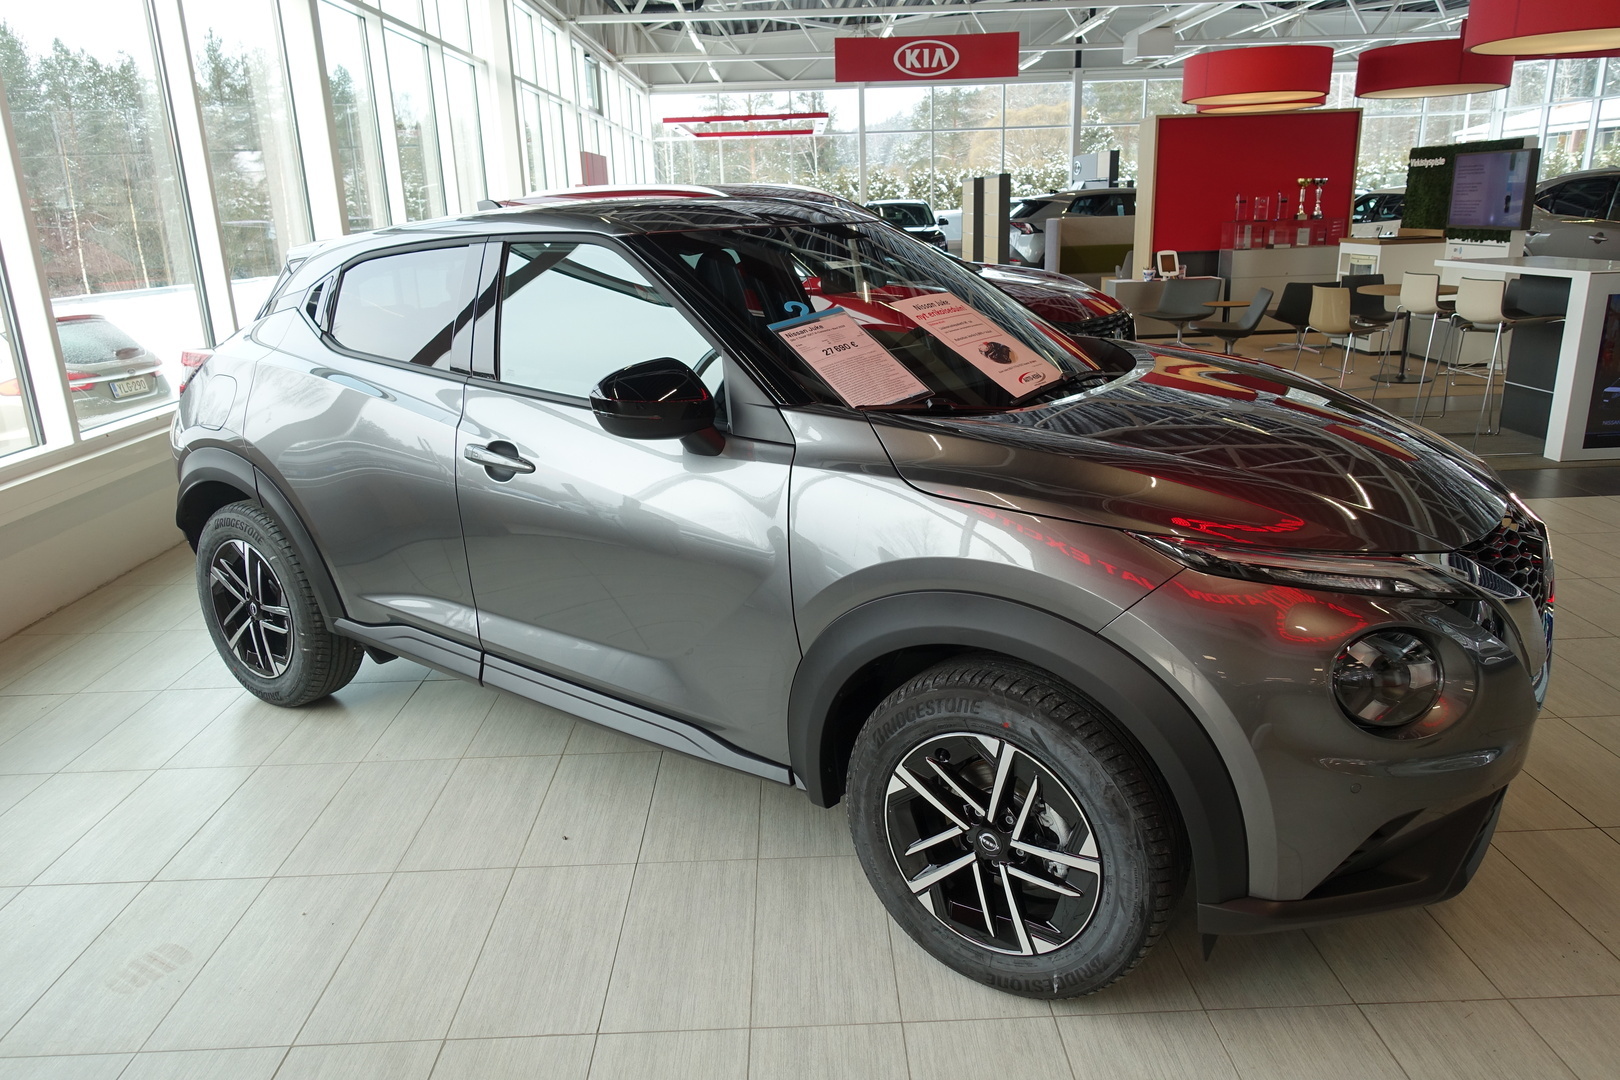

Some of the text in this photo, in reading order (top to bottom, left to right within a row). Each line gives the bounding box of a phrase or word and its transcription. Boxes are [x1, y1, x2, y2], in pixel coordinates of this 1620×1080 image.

[904, 48, 949, 69] KIA
[912, 299, 951, 311] Nissan Juke
[915, 313, 930, 321] nyt
[785, 327, 809, 339] Nissan
[808, 324, 825, 332] Juke
[822, 347, 834, 356] 27
[117, 379, 148, 394] YLG-290
[214, 517, 265, 546] BRIDGESTONE
[871, 698, 983, 747] BRIDGESTONE
[985, 953, 1107, 994] BRIDGESTONE
